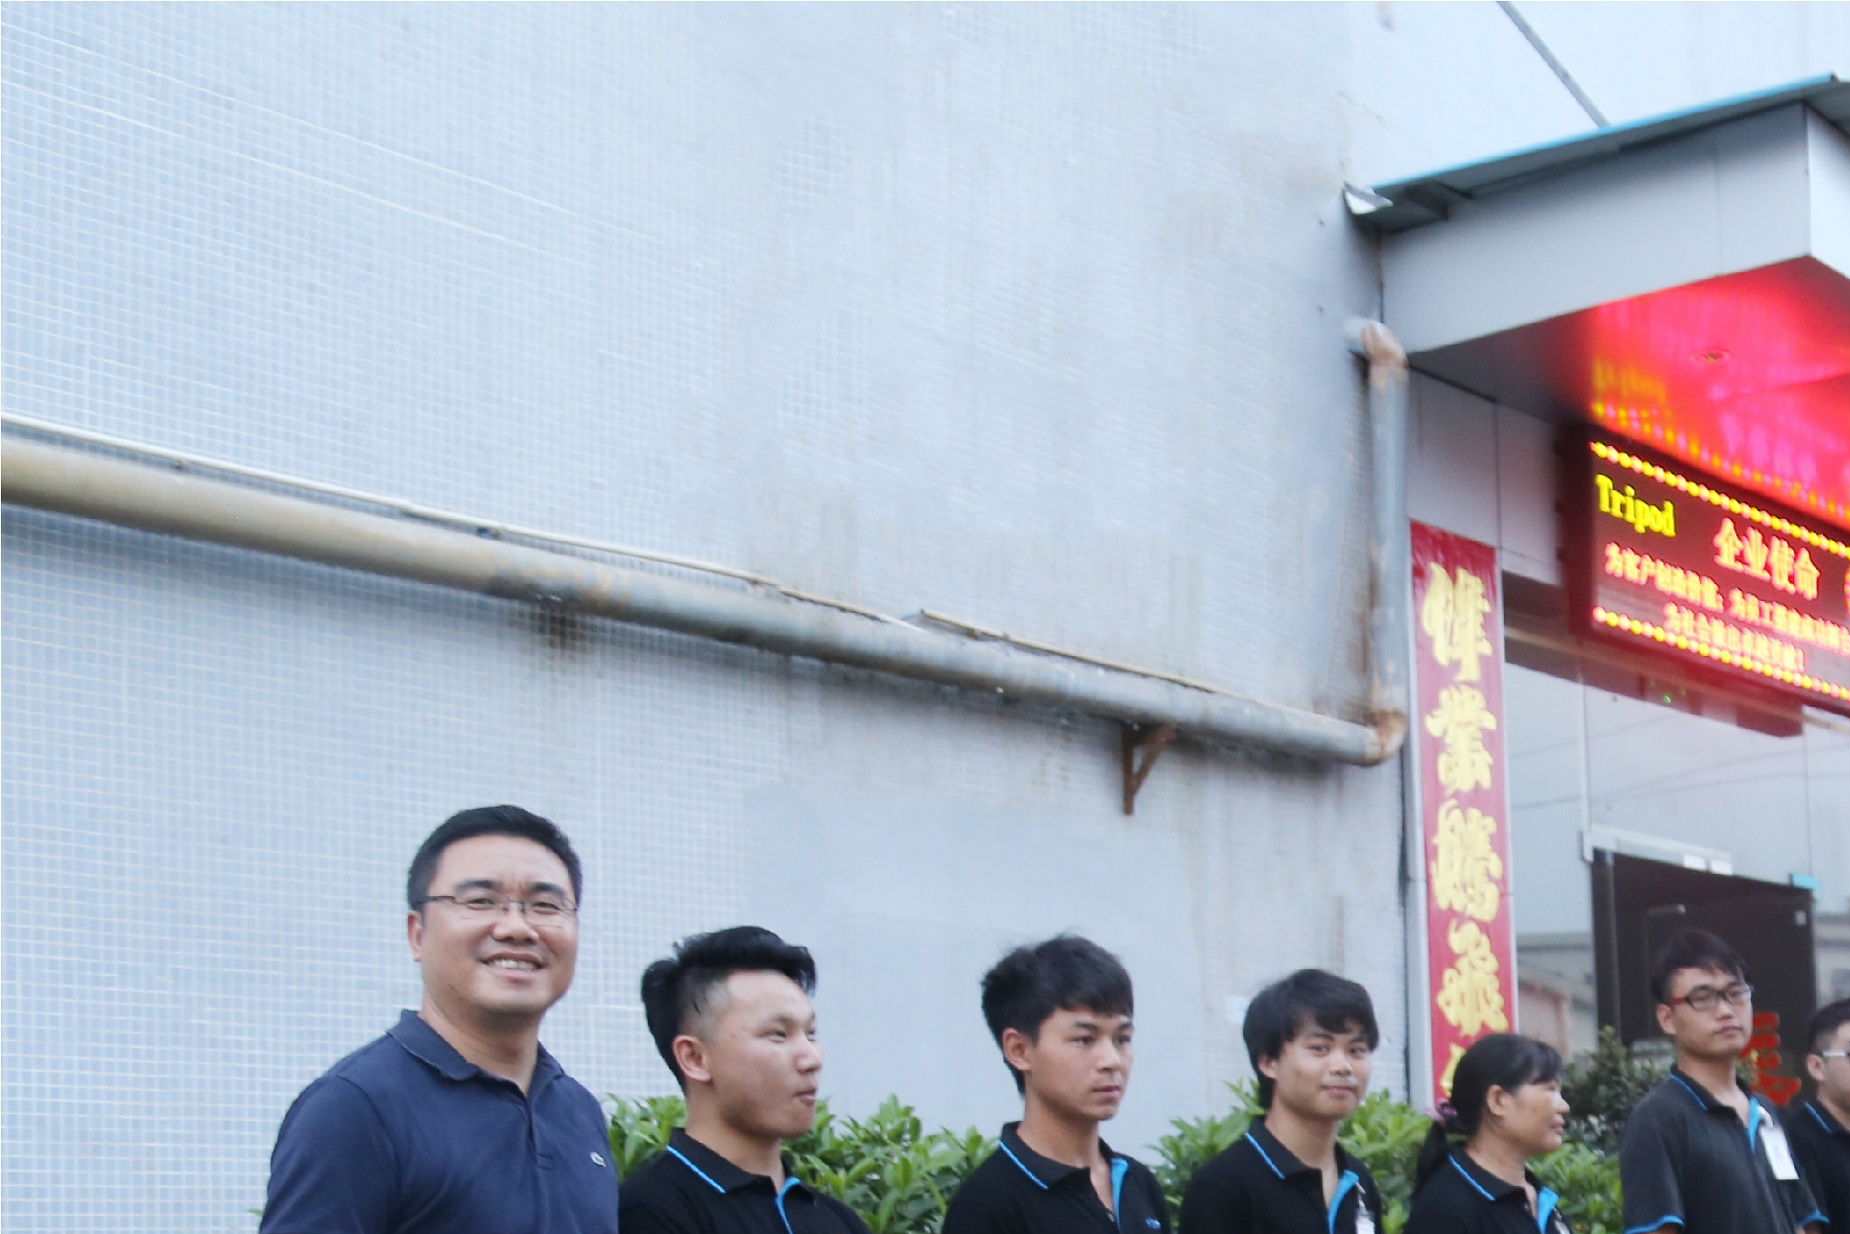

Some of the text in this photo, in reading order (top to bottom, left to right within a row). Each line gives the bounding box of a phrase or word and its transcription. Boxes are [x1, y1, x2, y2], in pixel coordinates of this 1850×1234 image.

[1595, 473, 1677, 538] Tripod
[1713, 517, 1820, 600] 企业使命
